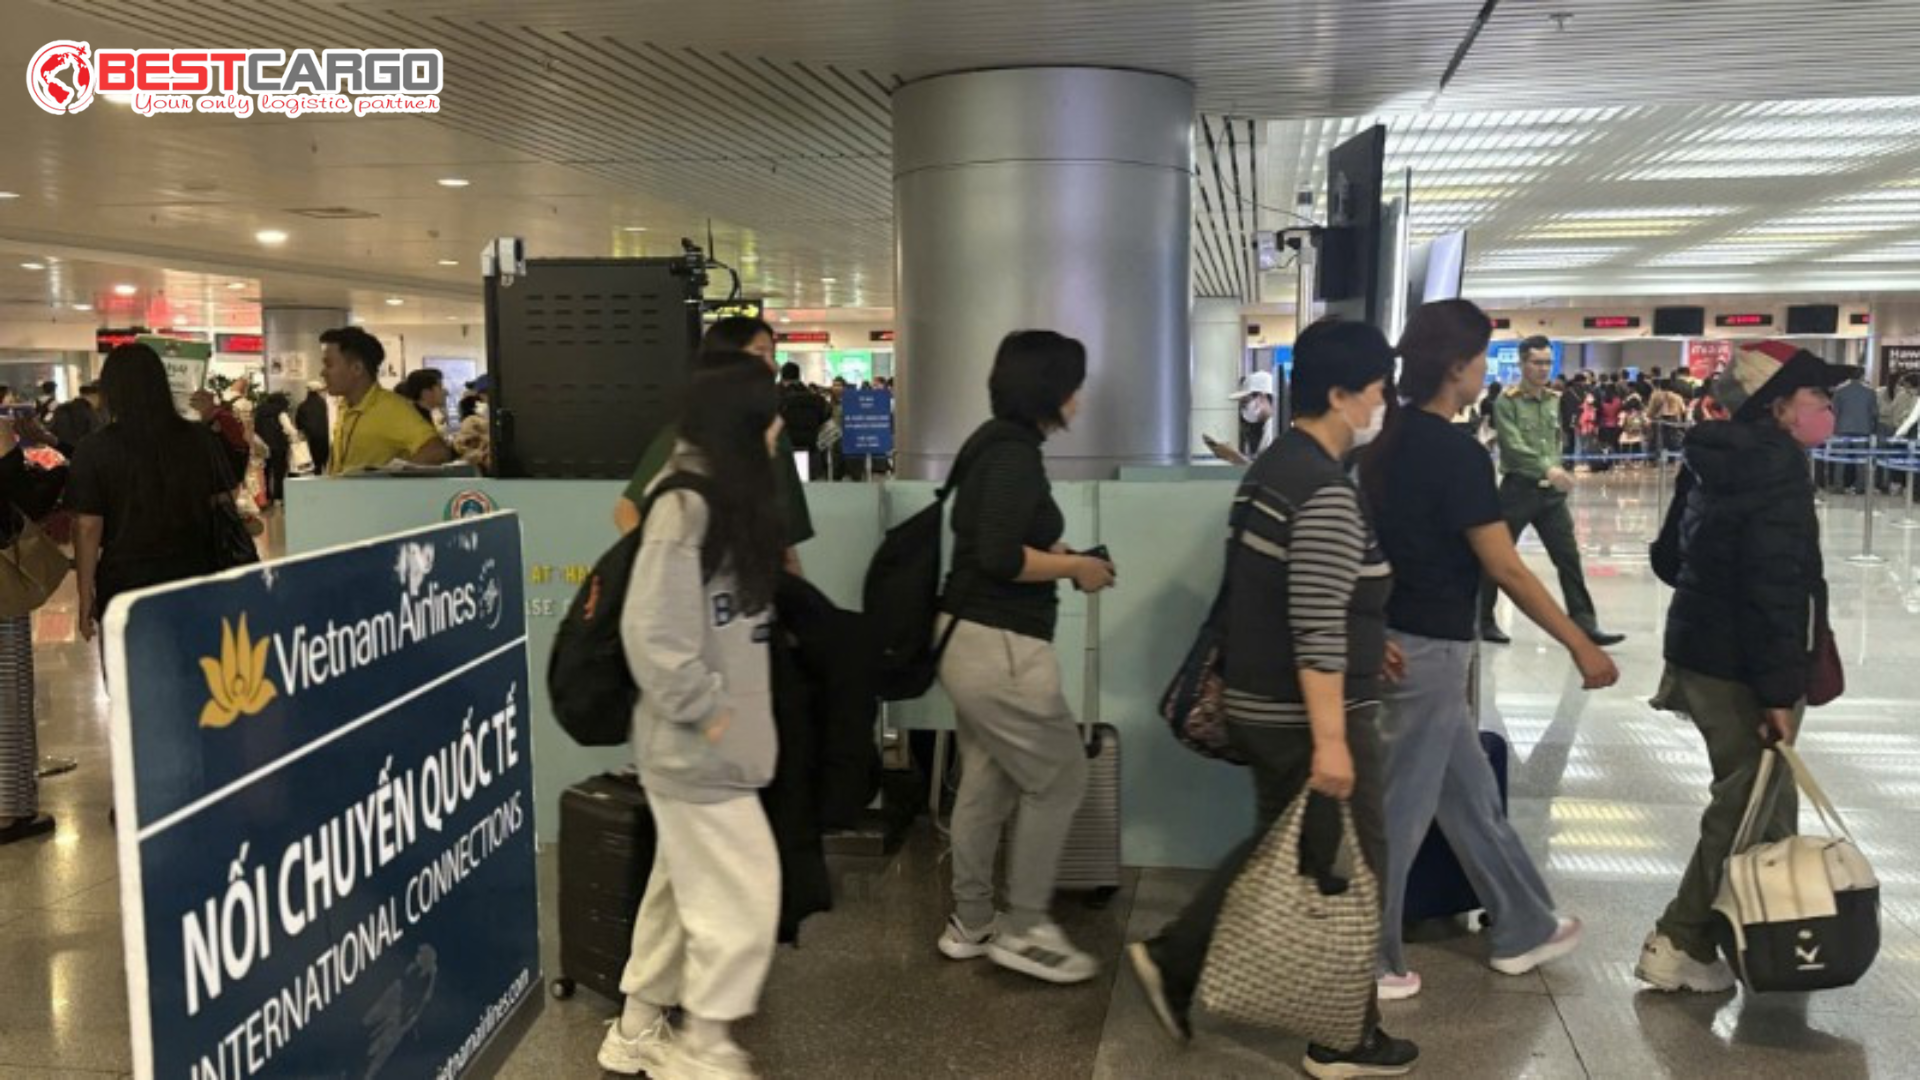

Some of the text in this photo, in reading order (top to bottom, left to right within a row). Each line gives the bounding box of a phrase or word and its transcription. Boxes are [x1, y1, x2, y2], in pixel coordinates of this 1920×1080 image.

[273, 582, 476, 696] Vietnam Airlines
[181, 681, 519, 1016] NỐI CHUYẾN QUỐC TẾ
[190, 790, 523, 1080] NTERNATIONAL CONNECTIONS
